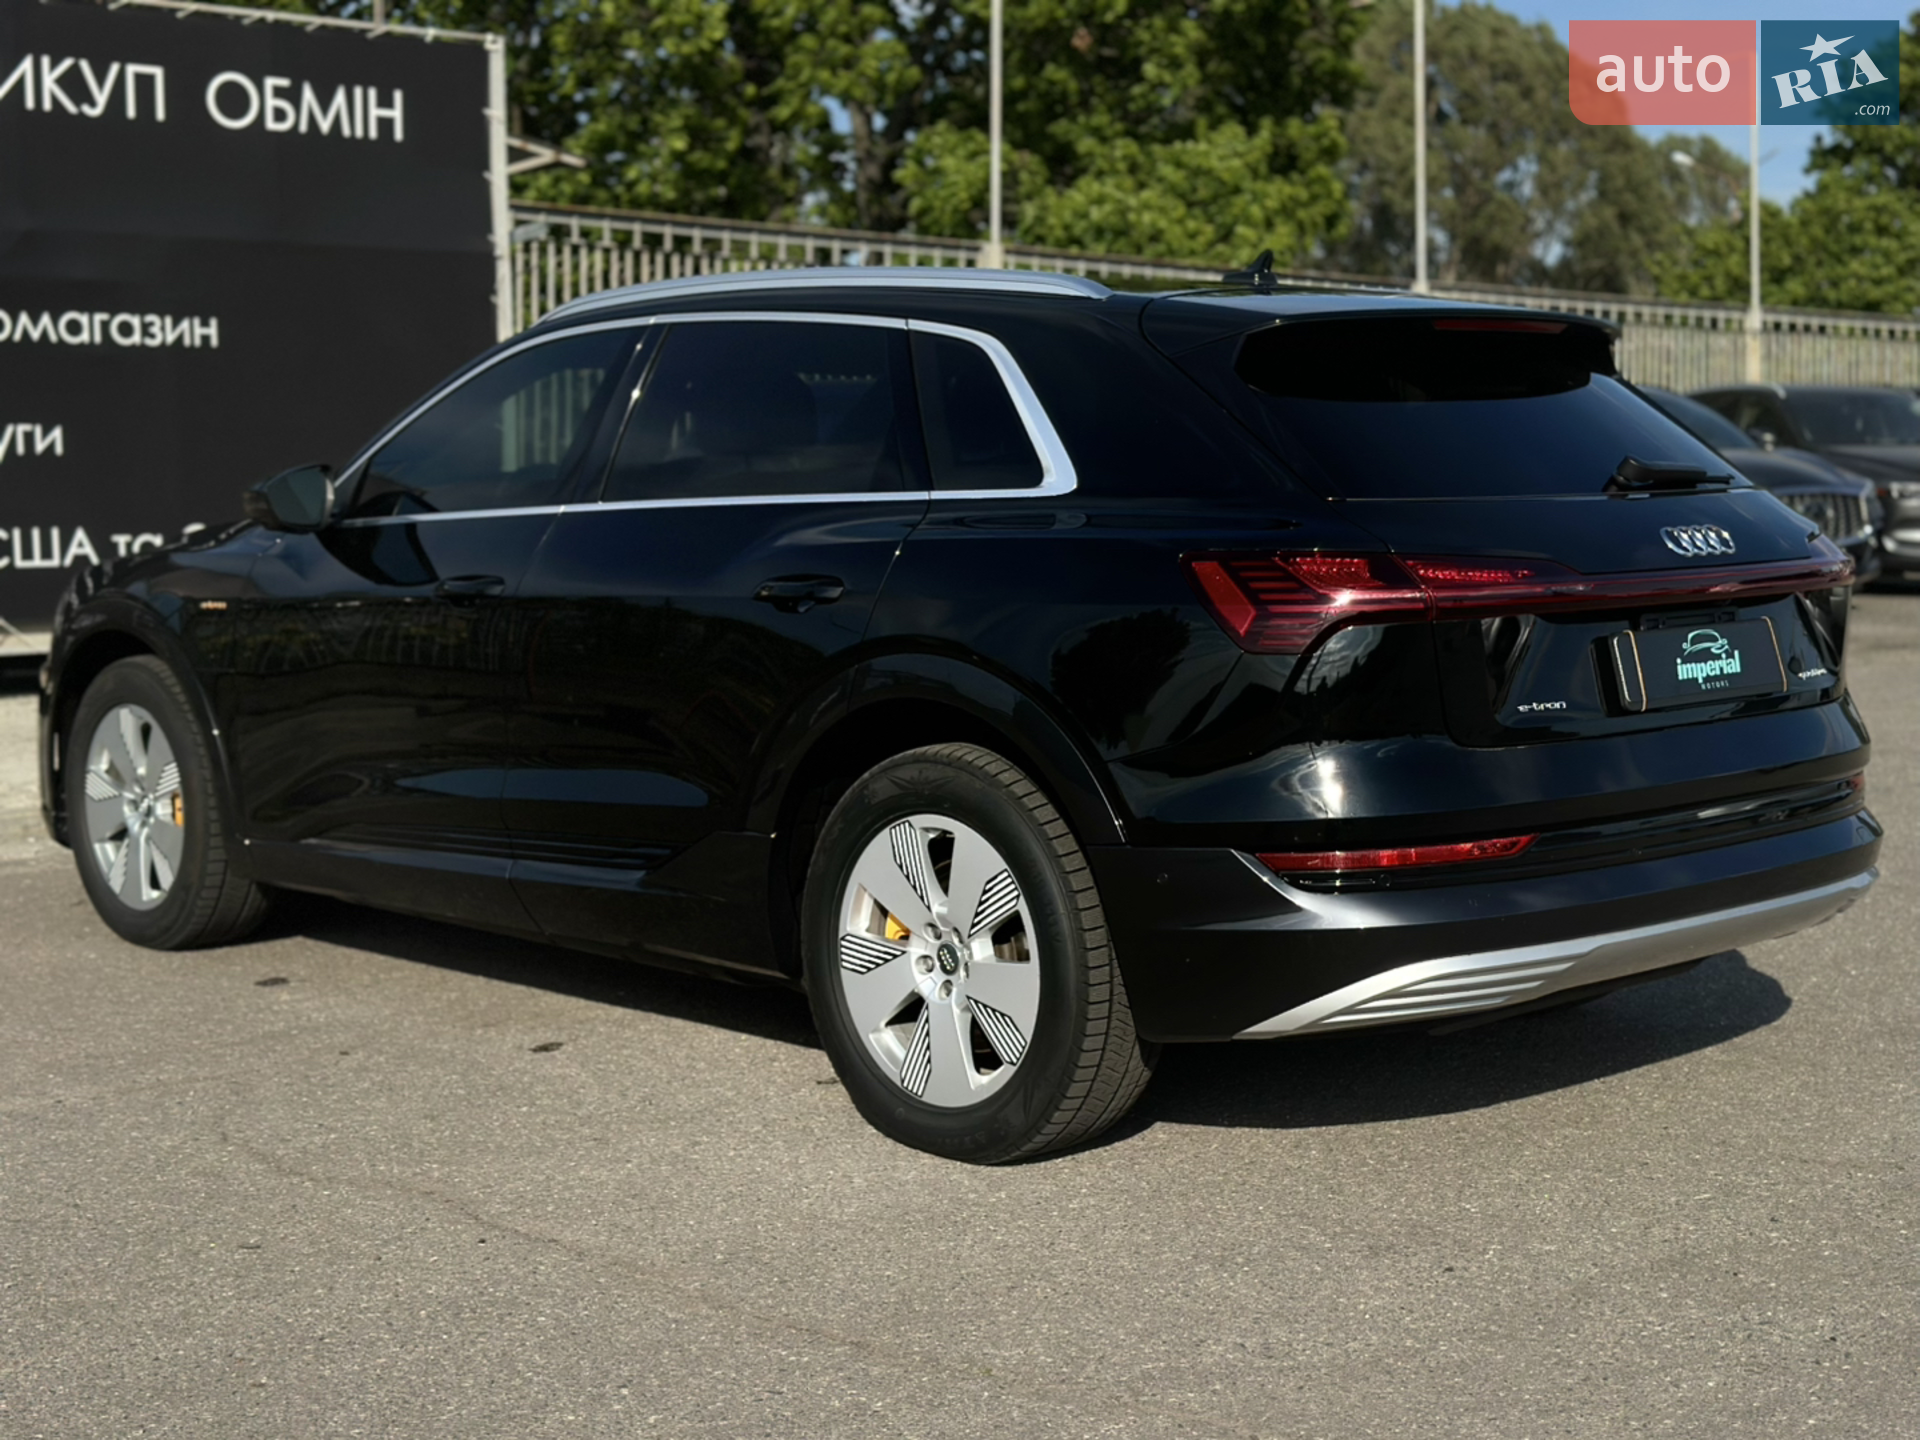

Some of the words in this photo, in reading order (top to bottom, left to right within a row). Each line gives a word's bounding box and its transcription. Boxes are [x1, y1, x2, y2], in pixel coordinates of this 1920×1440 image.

[205, 70, 404, 143] ОБМІН
[1676, 649, 1741, 684] imperial
[1517, 701, 1567, 713] e-tron
